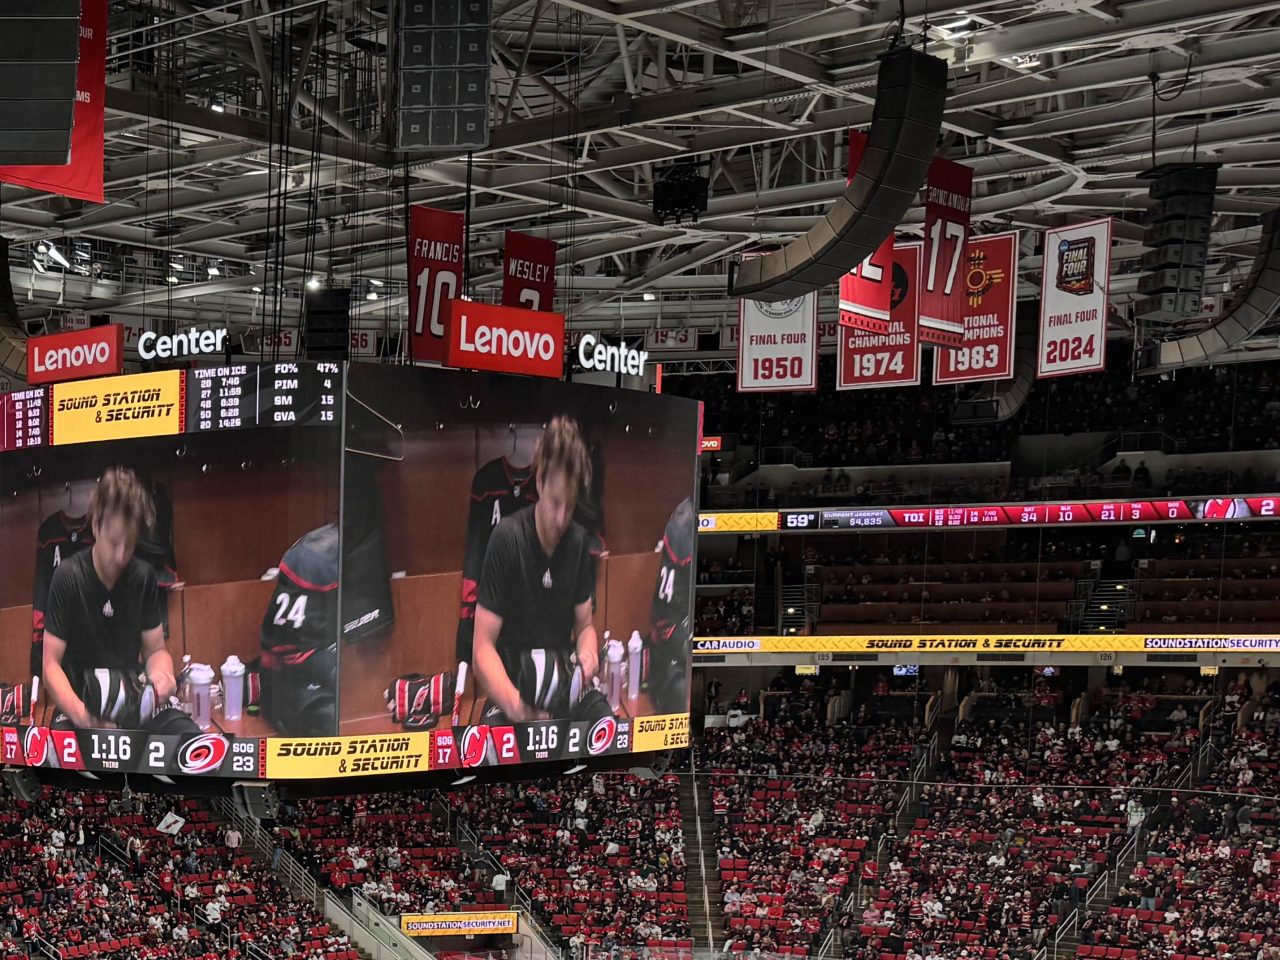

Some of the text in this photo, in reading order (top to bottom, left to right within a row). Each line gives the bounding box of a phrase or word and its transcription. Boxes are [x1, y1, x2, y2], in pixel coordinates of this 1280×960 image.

[414, 238, 460, 263] FRANCIS
[927, 218, 965, 295] 17
[1063, 248, 1088, 263] FINAL
[509, 257, 550, 283] WESLEY
[1062, 261, 1087, 276] FOUR
[415, 267, 457, 338] 10
[1048, 308, 1098, 327] FINAL FOUR
[459, 315, 648, 377] Lenovo Center
[750, 332, 806, 345] FINAL FOUR
[848, 334, 910, 348] CHAMPIONS
[33, 340, 111, 373] Lenovo
[138, 328, 227, 360] Center
[1046, 334, 1095, 364] 2024
[853, 352, 904, 377] 1974
[949, 344, 999, 372] 1983
[195, 365, 247, 379] TIME ON ICE
[274, 363, 338, 374] FO% 47%
[753, 357, 803, 380] 1950
[275, 379, 332, 390] PIM 4
[57, 389, 161, 412] SOUND STATION
[321, 395, 334, 405] 15
[95, 404, 174, 423] & SECURITY
[274, 411, 334, 422] GVA 15
[1131, 509, 1140, 519] 3
[1261, 499, 1274, 515] 2
[849, 518, 882, 526] $4,835
[903, 513, 925, 522] TOI
[1021, 512, 1037, 523] 34
[1058, 512, 1072, 521] 10
[1101, 510, 1115, 520] 21
[659, 566, 675, 603] 24
[274, 594, 307, 628] 24
[866, 638, 1066, 649] SOUND STATION & SECURITY
[617, 723, 629, 732] SOG
[638, 719, 665, 732] SOUND
[437, 736, 452, 746] SOG
[526, 727, 558, 750] 1:16
[569, 729, 580, 751] 2
[617, 734, 628, 748] 23
[6, 746, 16, 758] 17
[64, 739, 76, 762] 2
[91, 735, 131, 760] 1:16
[149, 742, 165, 767] 2
[232, 743, 254, 753] SOG
[278, 738, 410, 756] SOUND STATION
[502, 736, 515, 758] 2
[233, 756, 254, 771] 23
[338, 754, 422, 772] & SECURITY
[438, 749, 449, 763] 17
